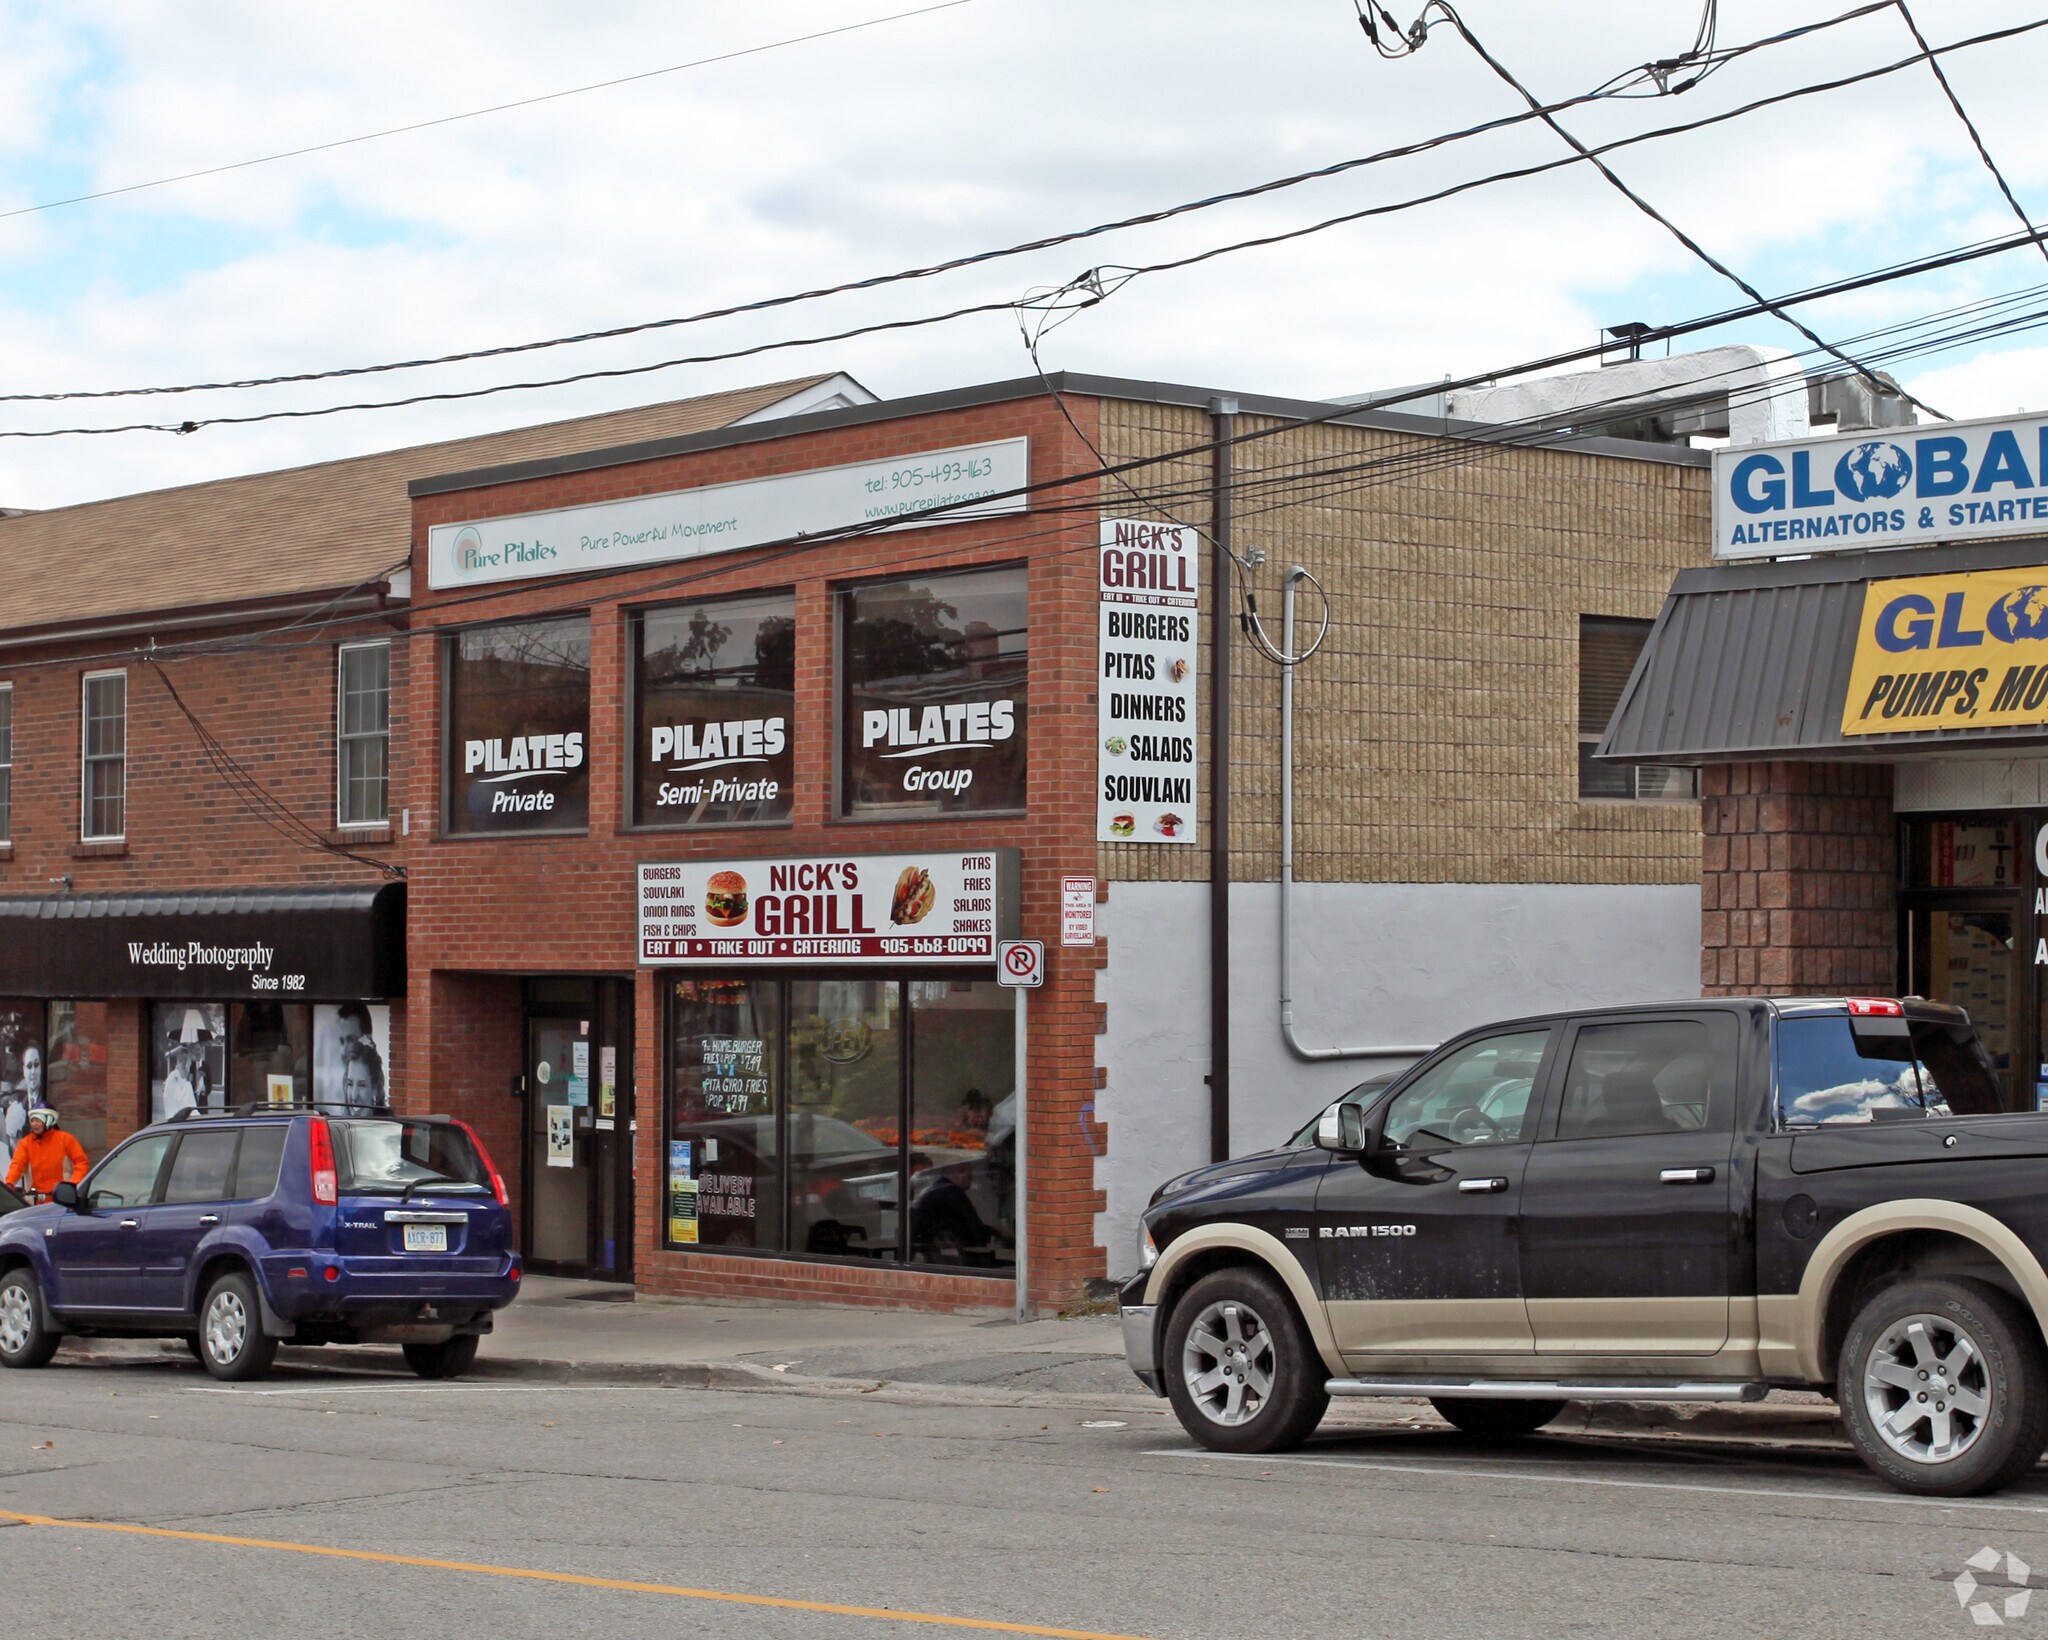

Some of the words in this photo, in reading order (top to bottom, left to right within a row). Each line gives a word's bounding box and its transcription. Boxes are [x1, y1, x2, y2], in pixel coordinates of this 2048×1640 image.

[865, 476, 887, 493] tel:
[892, 457, 992, 489] 905-493-1163
[1730, 425, 2048, 514] GLOBA
[580, 535, 609, 551] Pure
[613, 526, 667, 547] Powerful
[671, 517, 738, 537] Movement
[1731, 509, 1905, 545] ALTERNATORS
[1918, 506, 1934, 529] &
[1949, 496, 2048, 527] STARTE
[1115, 522, 1183, 552] NICK'S
[465, 548, 500, 569] Pure
[504, 540, 557, 564] Pilates
[1103, 549, 1195, 592] GRILL
[1103, 593, 1115, 601] EAT
[1116, 593, 1123, 601] IN
[1132, 594, 1148, 603] TAKE
[1148, 596, 1161, 604] OUT
[1167, 597, 1196, 607] CATERING
[1108, 611, 1190, 642] BURGERS
[1105, 652, 1155, 681] PITAS
[1859, 667, 1989, 720] PUMPS,
[1110, 693, 1186, 723] DINNERS
[863, 700, 1015, 748] PILATES
[465, 732, 583, 774] PILATES
[652, 717, 785, 762] PILATES
[1130, 735, 1193, 763] SALADS
[656, 777, 779, 806] Semi-Private
[903, 766, 973, 796] Group
[1104, 775, 1191, 804] SOUVLAKI
[491, 789, 555, 813] Private
[643, 868, 681, 880] BURGERS
[770, 862, 858, 892] NICK'S
[962, 857, 991, 870] PITAS
[643, 887, 684, 899] SOUVLAKI
[964, 877, 991, 891] FRIES
[1065, 881, 1092, 891] WARNING
[643, 906, 668, 918] ONION
[671, 905, 695, 917] RINGS
[755, 894, 875, 936] GRILL
[953, 898, 991, 912] SALADS
[1065, 910, 1092, 919] MONITORED
[643, 925, 662, 937] FISH
[664, 924, 670, 936] &
[672, 924, 697, 936] CHIPS
[953, 919, 991, 933] SHAKES
[1065, 932, 1092, 940] SURVEILLANCE
[128, 942, 187, 971] Wedding
[188, 941, 274, 971] Photography
[646, 940, 671, 955] EAT
[675, 940, 689, 955] IN
[709, 940, 744, 955] TAKE
[747, 940, 775, 955] OUT
[793, 939, 861, 955] CATERING
[880, 938, 987, 954] 905-668-0099
[252, 974, 278, 990] Since
[282, 974, 305, 990] 1982
[703, 1053, 719, 1064] FRIES
[704, 1078, 720, 1092] PITA
[745, 1078, 768, 1094] FRIES
[699, 1173, 753, 1195] DELIVERY
[696, 1194, 755, 1218] AVAILABLE
[1319, 1226, 1368, 1238] RAM
[1371, 1224, 1417, 1237] 1500
